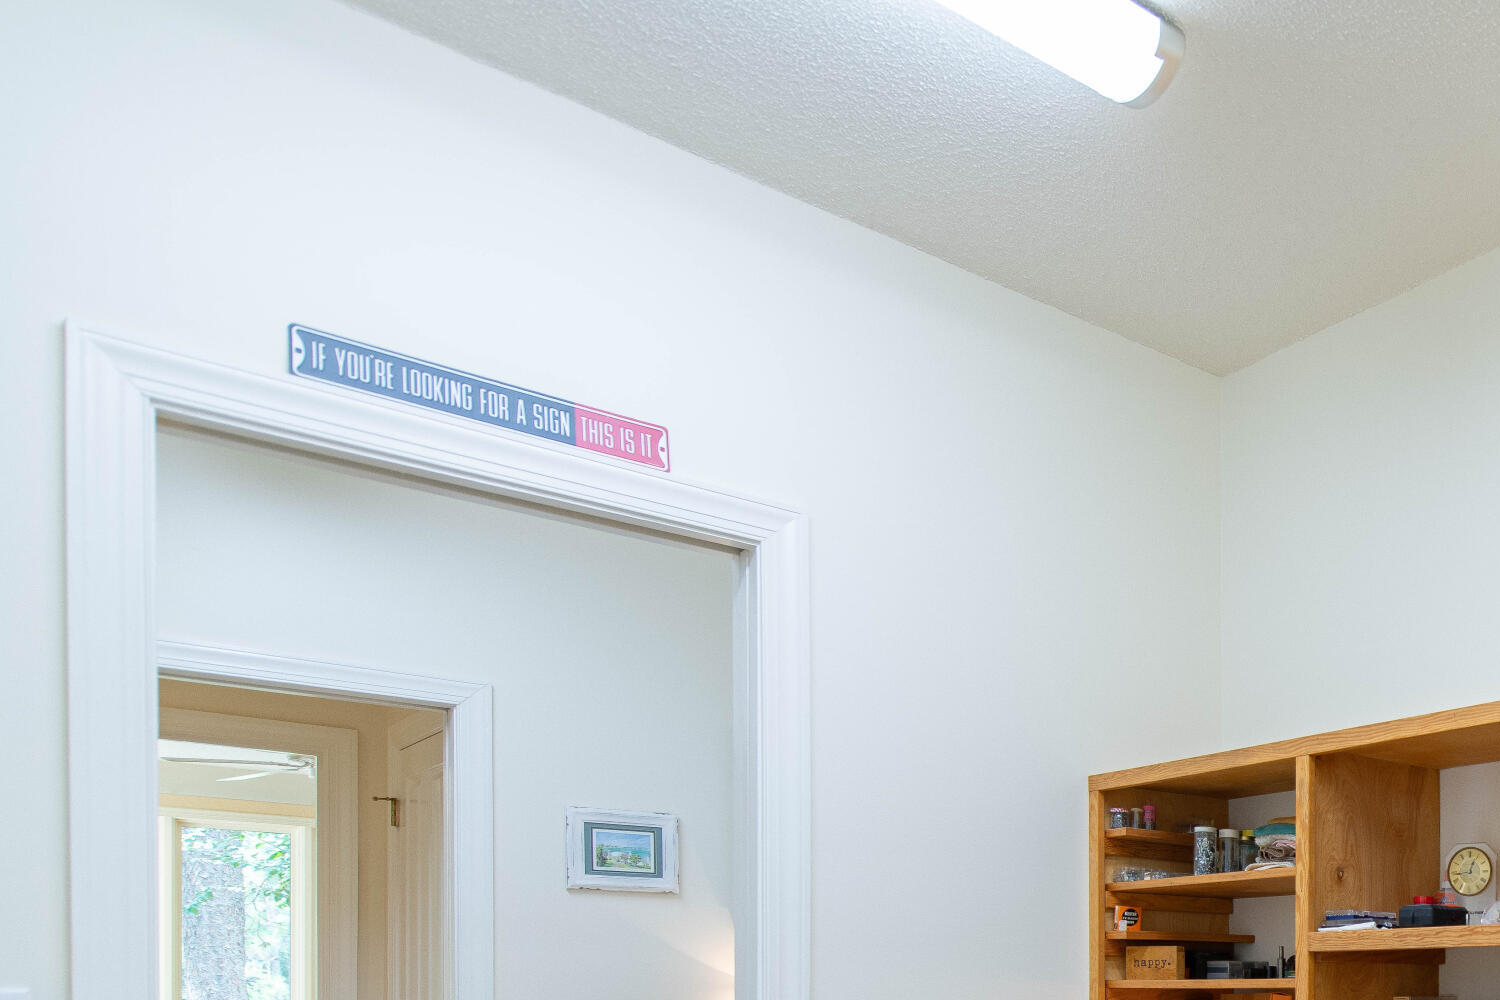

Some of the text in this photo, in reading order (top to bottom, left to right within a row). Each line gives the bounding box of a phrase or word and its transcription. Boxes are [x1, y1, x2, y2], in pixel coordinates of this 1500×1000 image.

[312, 341, 653, 458] IF YOU'RE LOOKING FOR A SIGN THIS IS IT
[1133, 957, 1171, 969] happy.
